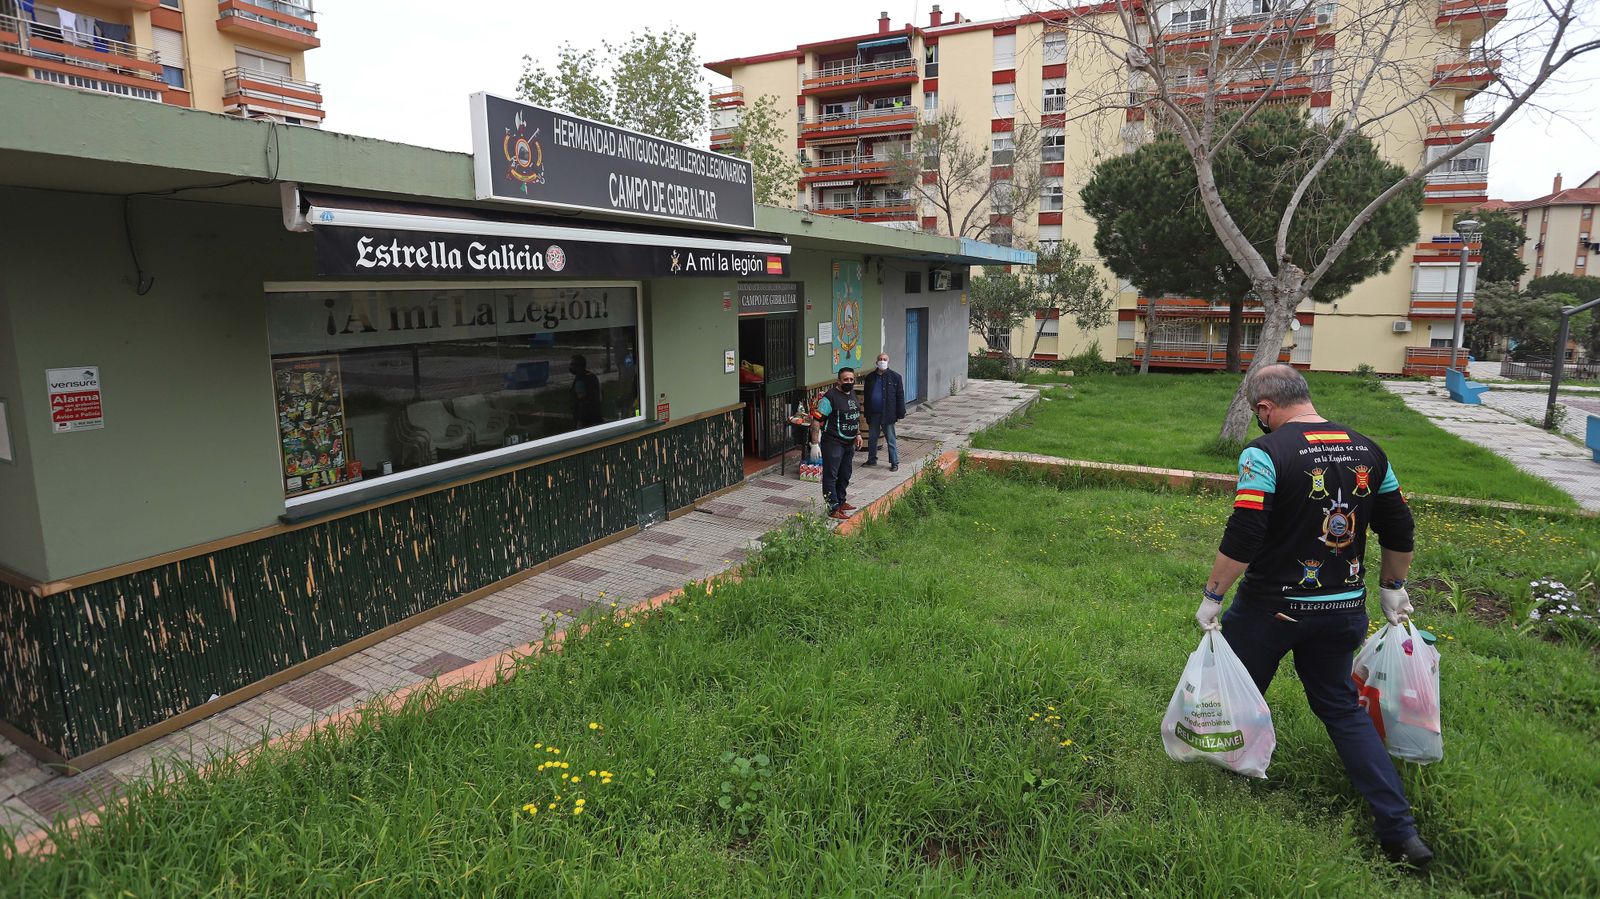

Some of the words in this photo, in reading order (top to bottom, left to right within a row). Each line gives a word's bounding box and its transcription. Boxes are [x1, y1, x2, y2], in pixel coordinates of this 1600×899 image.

[553, 117, 616, 157] HERMANDAD
[617, 134, 659, 166] ANTIGUOS
[659, 144, 706, 176] CABALLEROS
[706, 155, 747, 185] LEGIONARIOS
[608, 172, 650, 211] CAMPO
[651, 180, 667, 213] DE
[667, 183, 718, 220] GIBRALTAR
[355, 235, 463, 270] Estrella
[467, 241, 545, 271] Galicia
[685, 252, 696, 271] A
[700, 252, 715, 271] mí
[718, 253, 729, 271] la
[731, 253, 763, 276] legión
[387, 294, 442, 331] mí
[453, 295, 496, 328] La
[504, 291, 609, 330] Legión!
[741, 295, 761, 307] CAMPO
[769, 293, 797, 305] GIBRALTAR
[51, 380, 97, 389] verisure
[53, 394, 99, 404] Alarma
